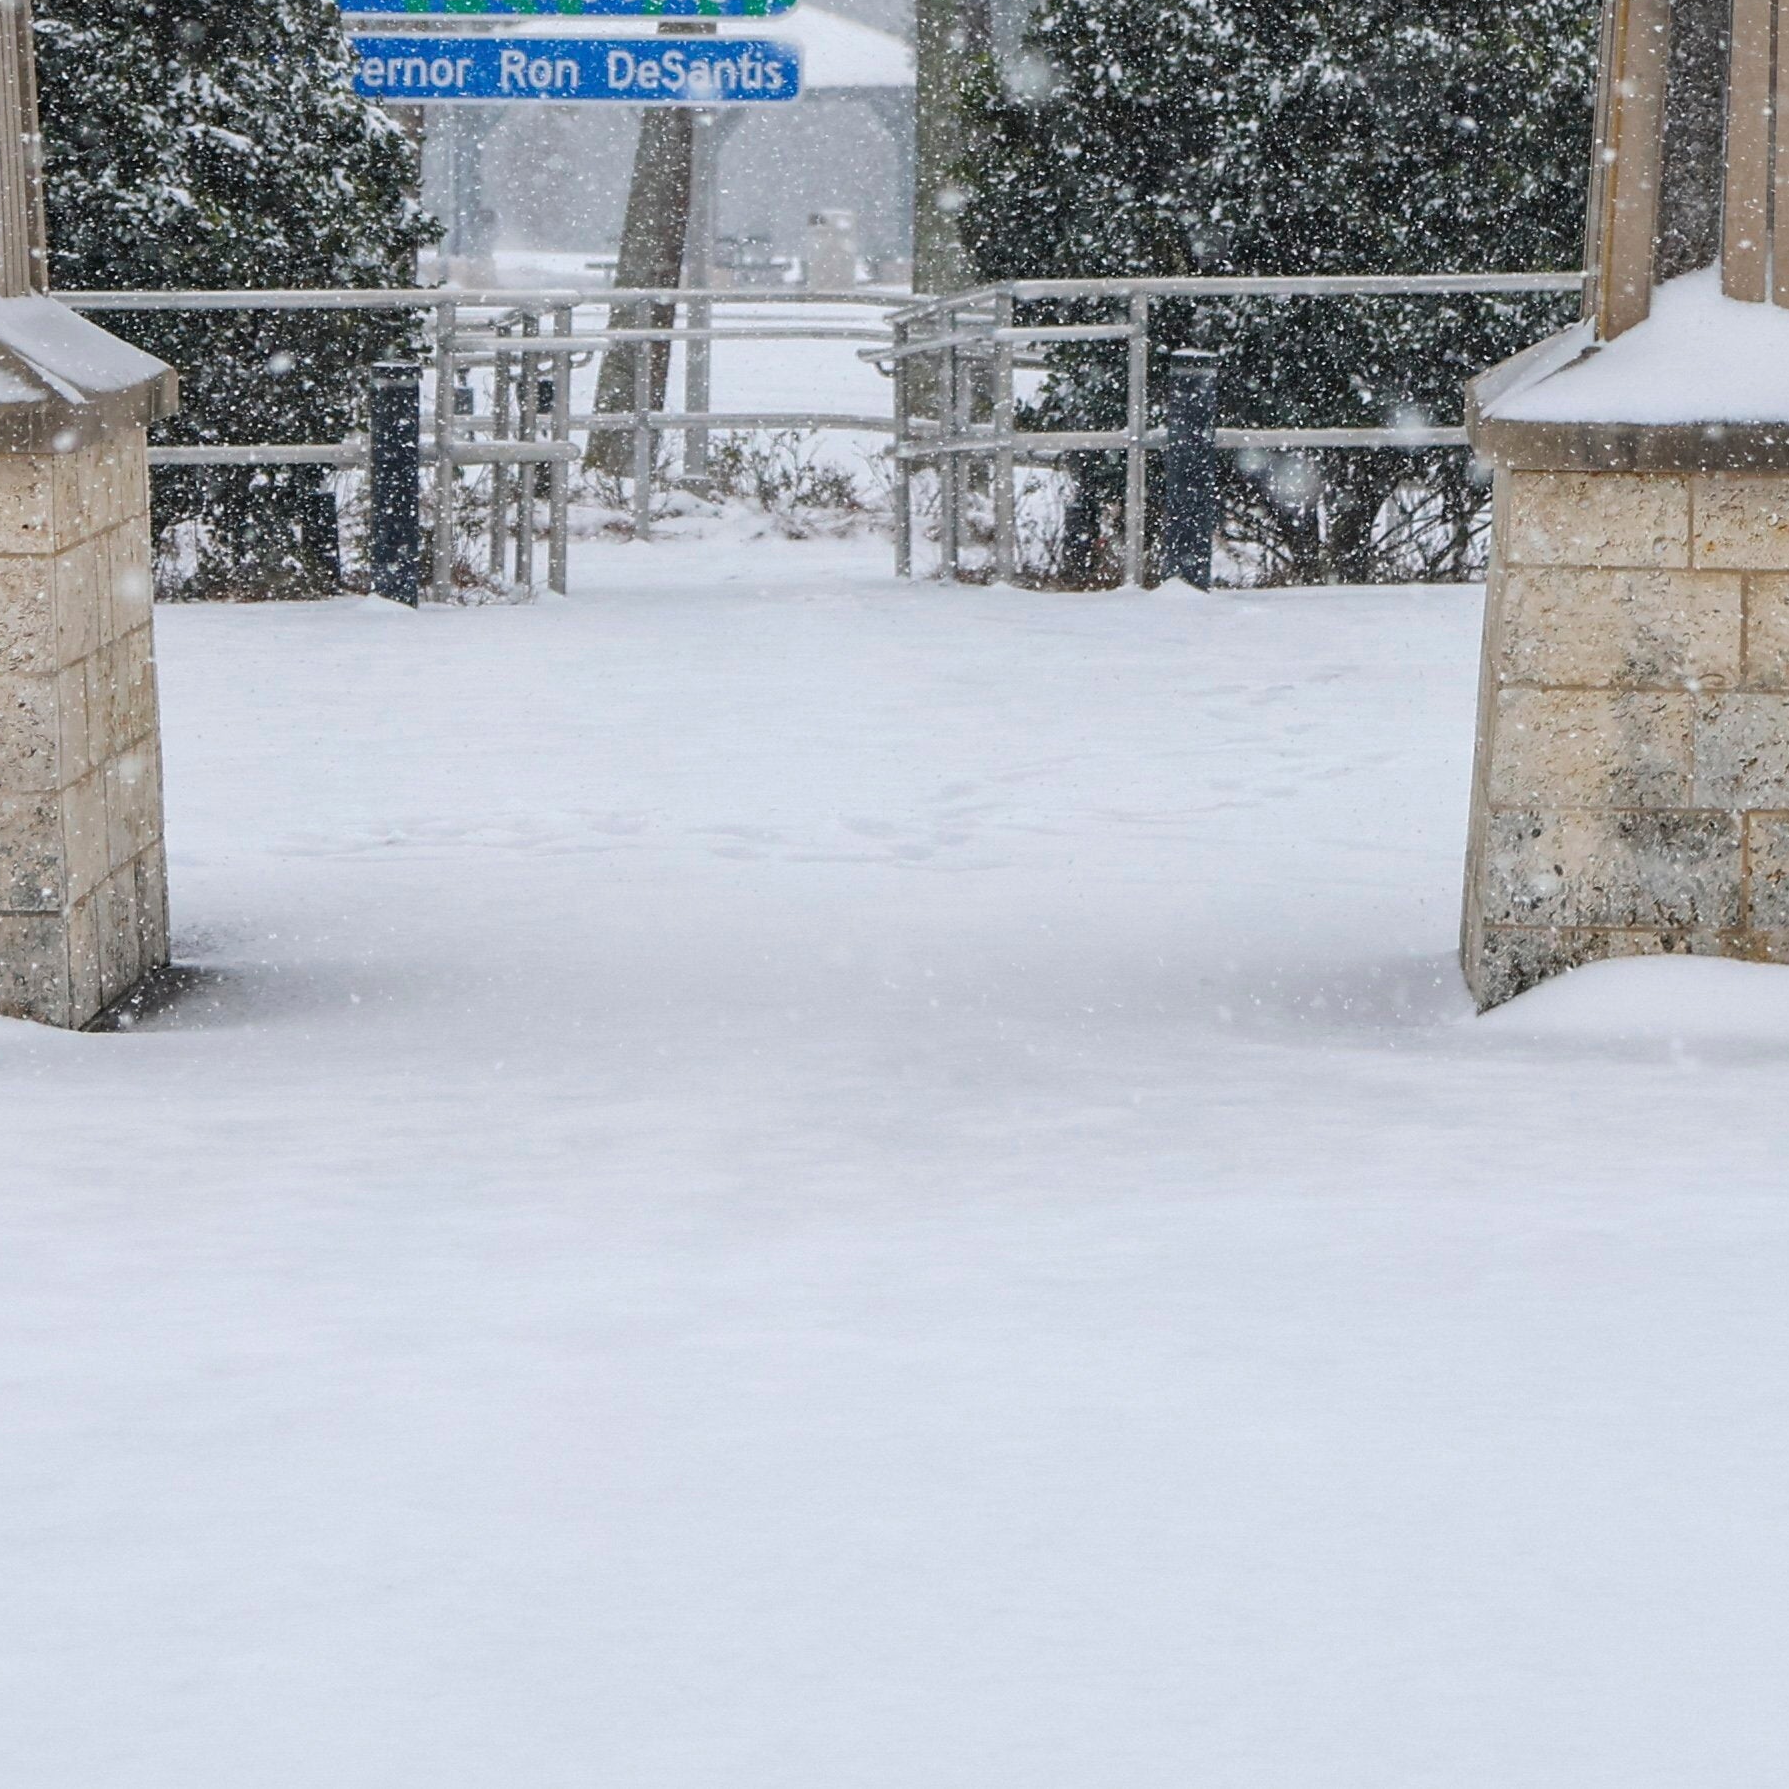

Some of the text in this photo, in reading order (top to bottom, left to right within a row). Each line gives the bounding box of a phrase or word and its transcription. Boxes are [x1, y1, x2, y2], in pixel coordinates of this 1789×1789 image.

[361, 49, 784, 91] ernor Ron DeSantis
